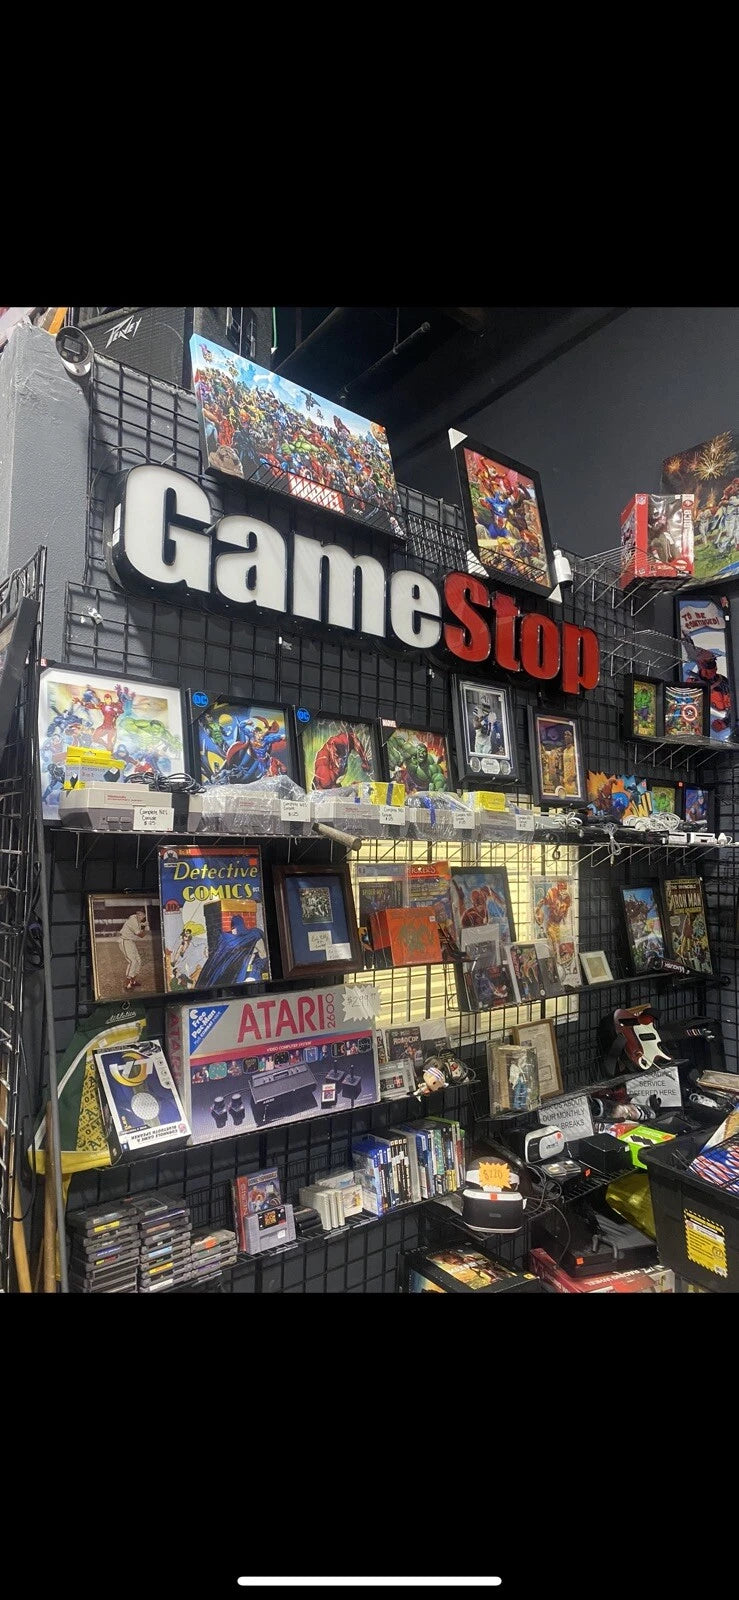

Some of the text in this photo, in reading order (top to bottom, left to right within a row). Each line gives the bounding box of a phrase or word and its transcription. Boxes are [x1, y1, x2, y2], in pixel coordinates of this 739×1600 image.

[681, 611, 706, 621] TO BE
[193, 693, 208, 706] DC
[297, 709, 310, 721] DC
[173, 860, 258, 881] Detective
[182, 883, 253, 902] COMICS
[192, 1010, 207, 1028] Free
[237, 993, 337, 1044] ATARI 2600
[542, 1113, 556, 1122] OUR
[556, 1108, 585, 1119] MONTHLY
[560, 1119, 585, 1130] BREAKS
